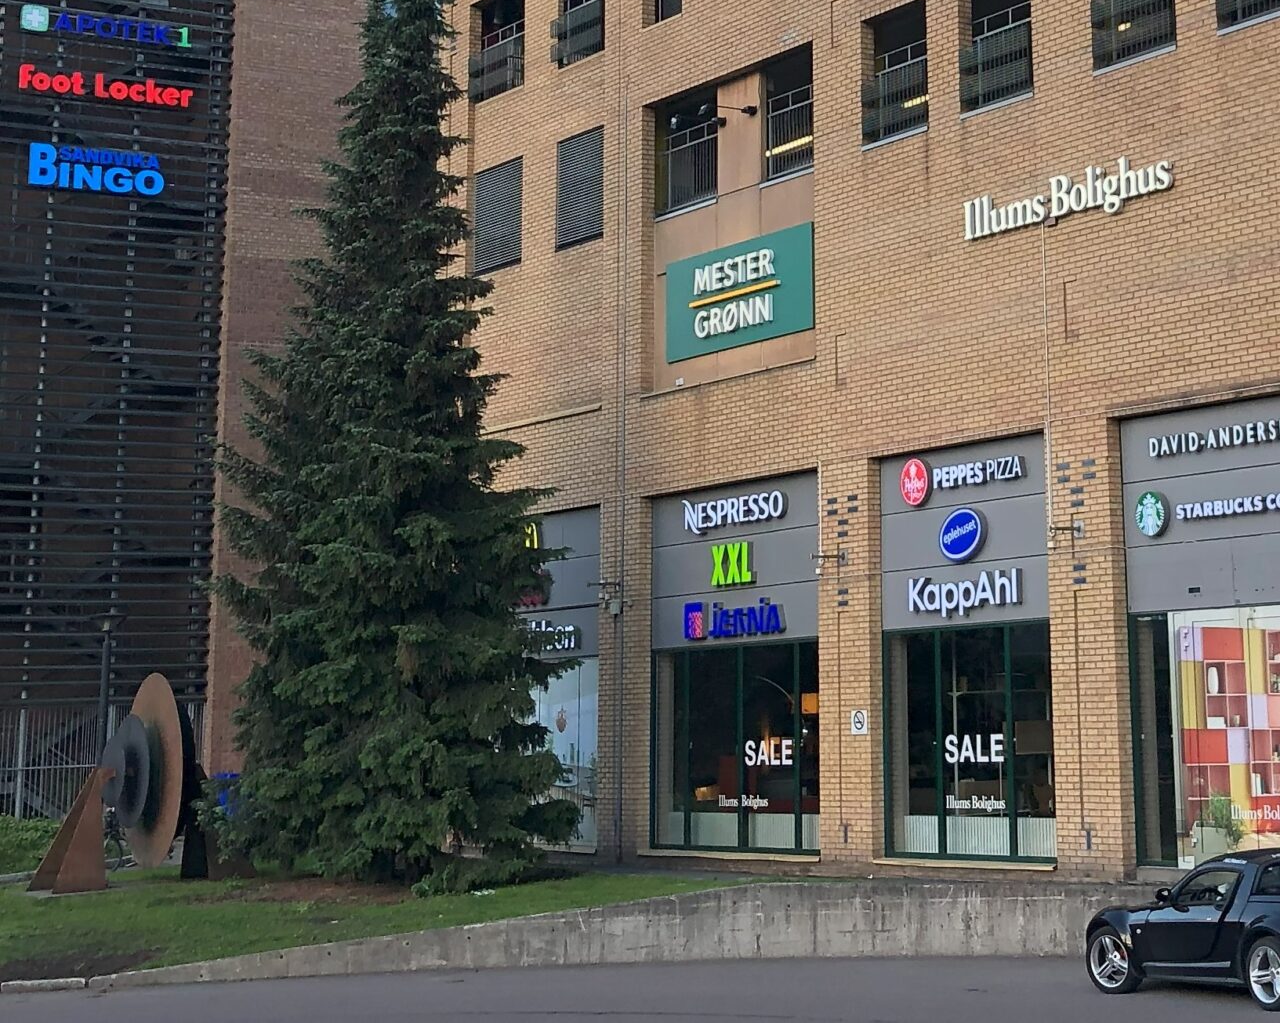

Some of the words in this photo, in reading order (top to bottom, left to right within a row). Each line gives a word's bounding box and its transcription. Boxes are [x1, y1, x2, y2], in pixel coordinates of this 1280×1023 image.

[54, 12, 171, 45] APOTEK
[177, 26, 192, 48] 1
[18, 64, 84, 95] Foot
[95, 73, 193, 108] Locker
[28, 142, 164, 196] BINGO
[963, 193, 1047, 240] Illums
[1049, 155, 1173, 218] Bolighus
[693, 248, 775, 295] MESTER
[694, 293, 774, 338] GRØNN
[932, 461, 984, 489] PEPPES
[986, 455, 1022, 481] PIZZA
[1175, 498, 1263, 521] STARBUCKS
[711, 541, 752, 586] XXL
[908, 568, 1018, 618] KappAhl
[744, 739, 793, 766] SALE
[944, 733, 1005, 763] SALE
[946, 795, 971, 809] Illums
[972, 795, 1006, 812] Bolighus
